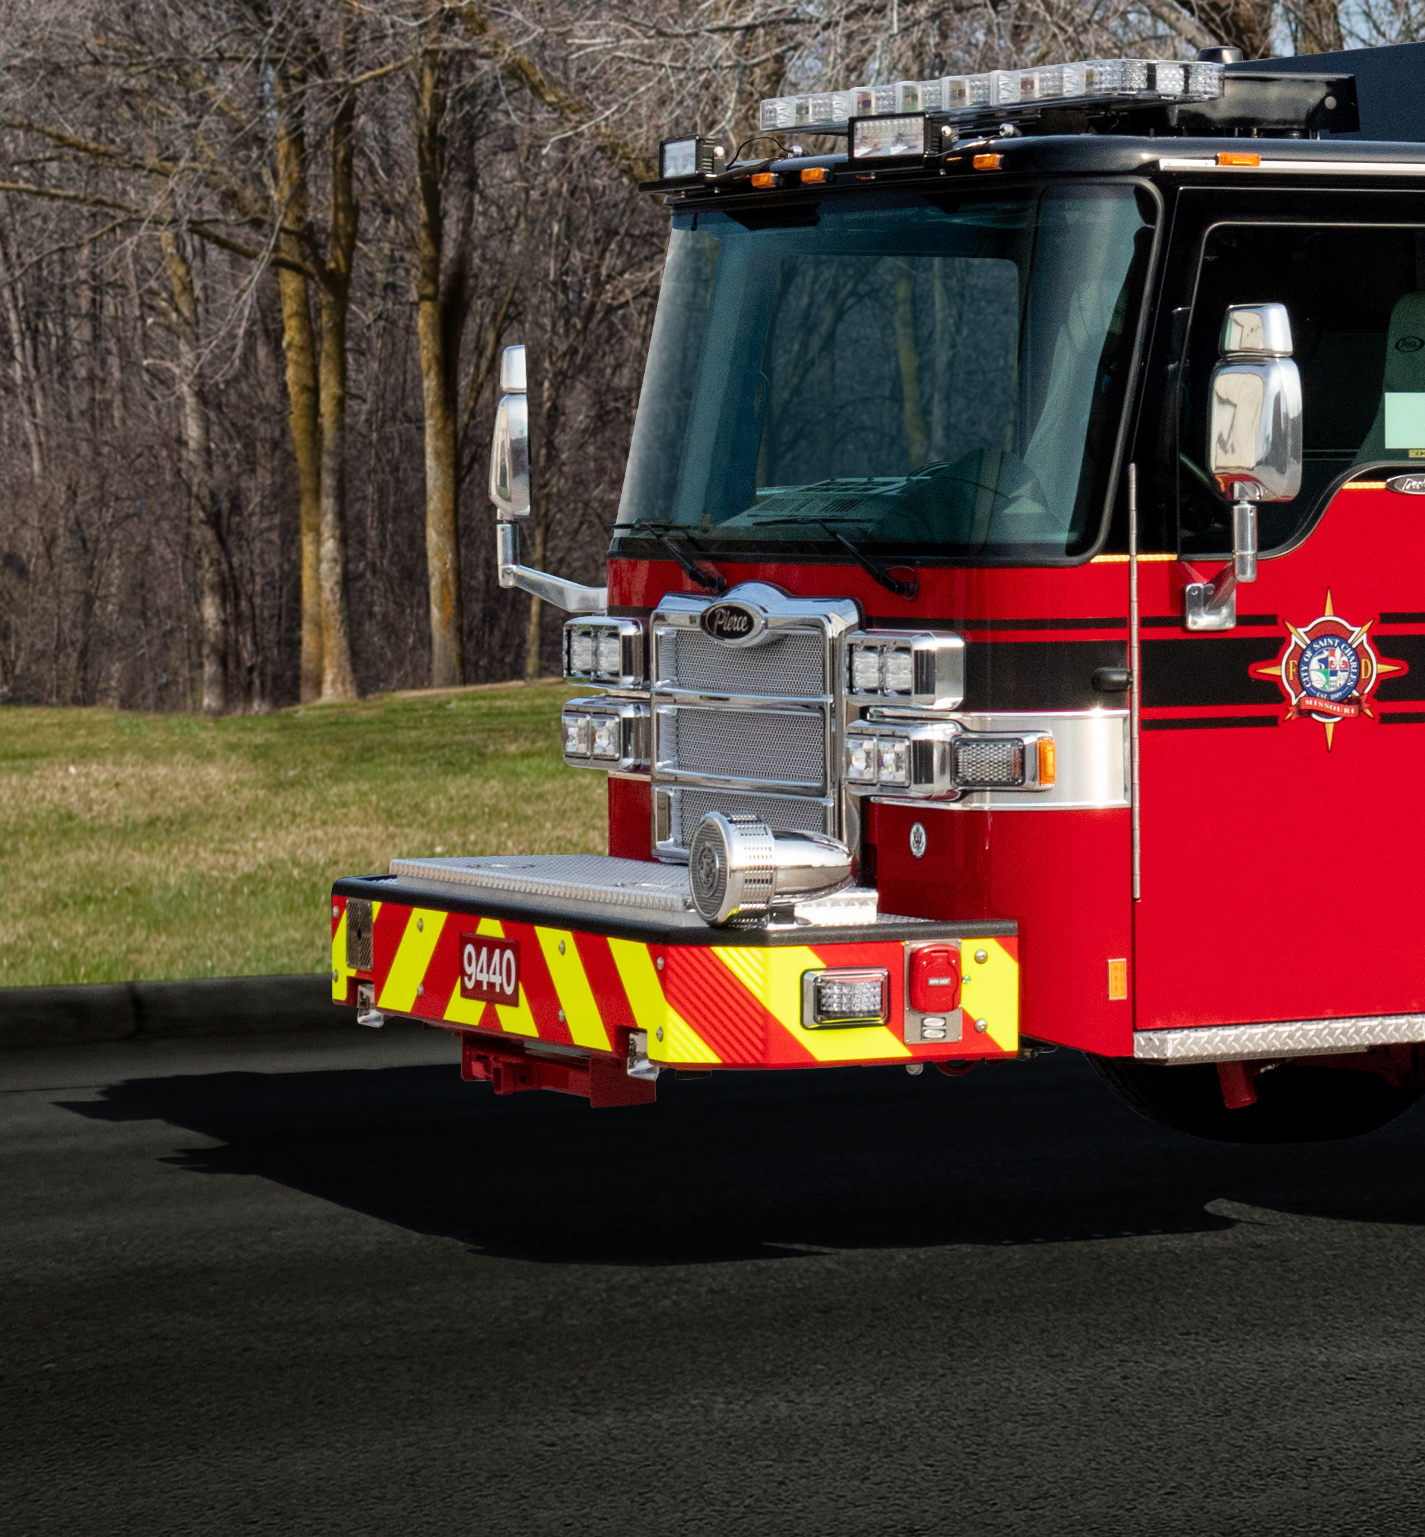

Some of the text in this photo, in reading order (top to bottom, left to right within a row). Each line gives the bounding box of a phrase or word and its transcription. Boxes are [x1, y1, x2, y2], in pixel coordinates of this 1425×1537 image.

[714, 608, 749, 635] Pierce
[1289, 658, 1372, 681] F D
[1300, 637, 1358, 688] CITY OF SAINT CHARLES
[1305, 699, 1355, 714] MISSOURI
[463, 943, 516, 995] 9440
